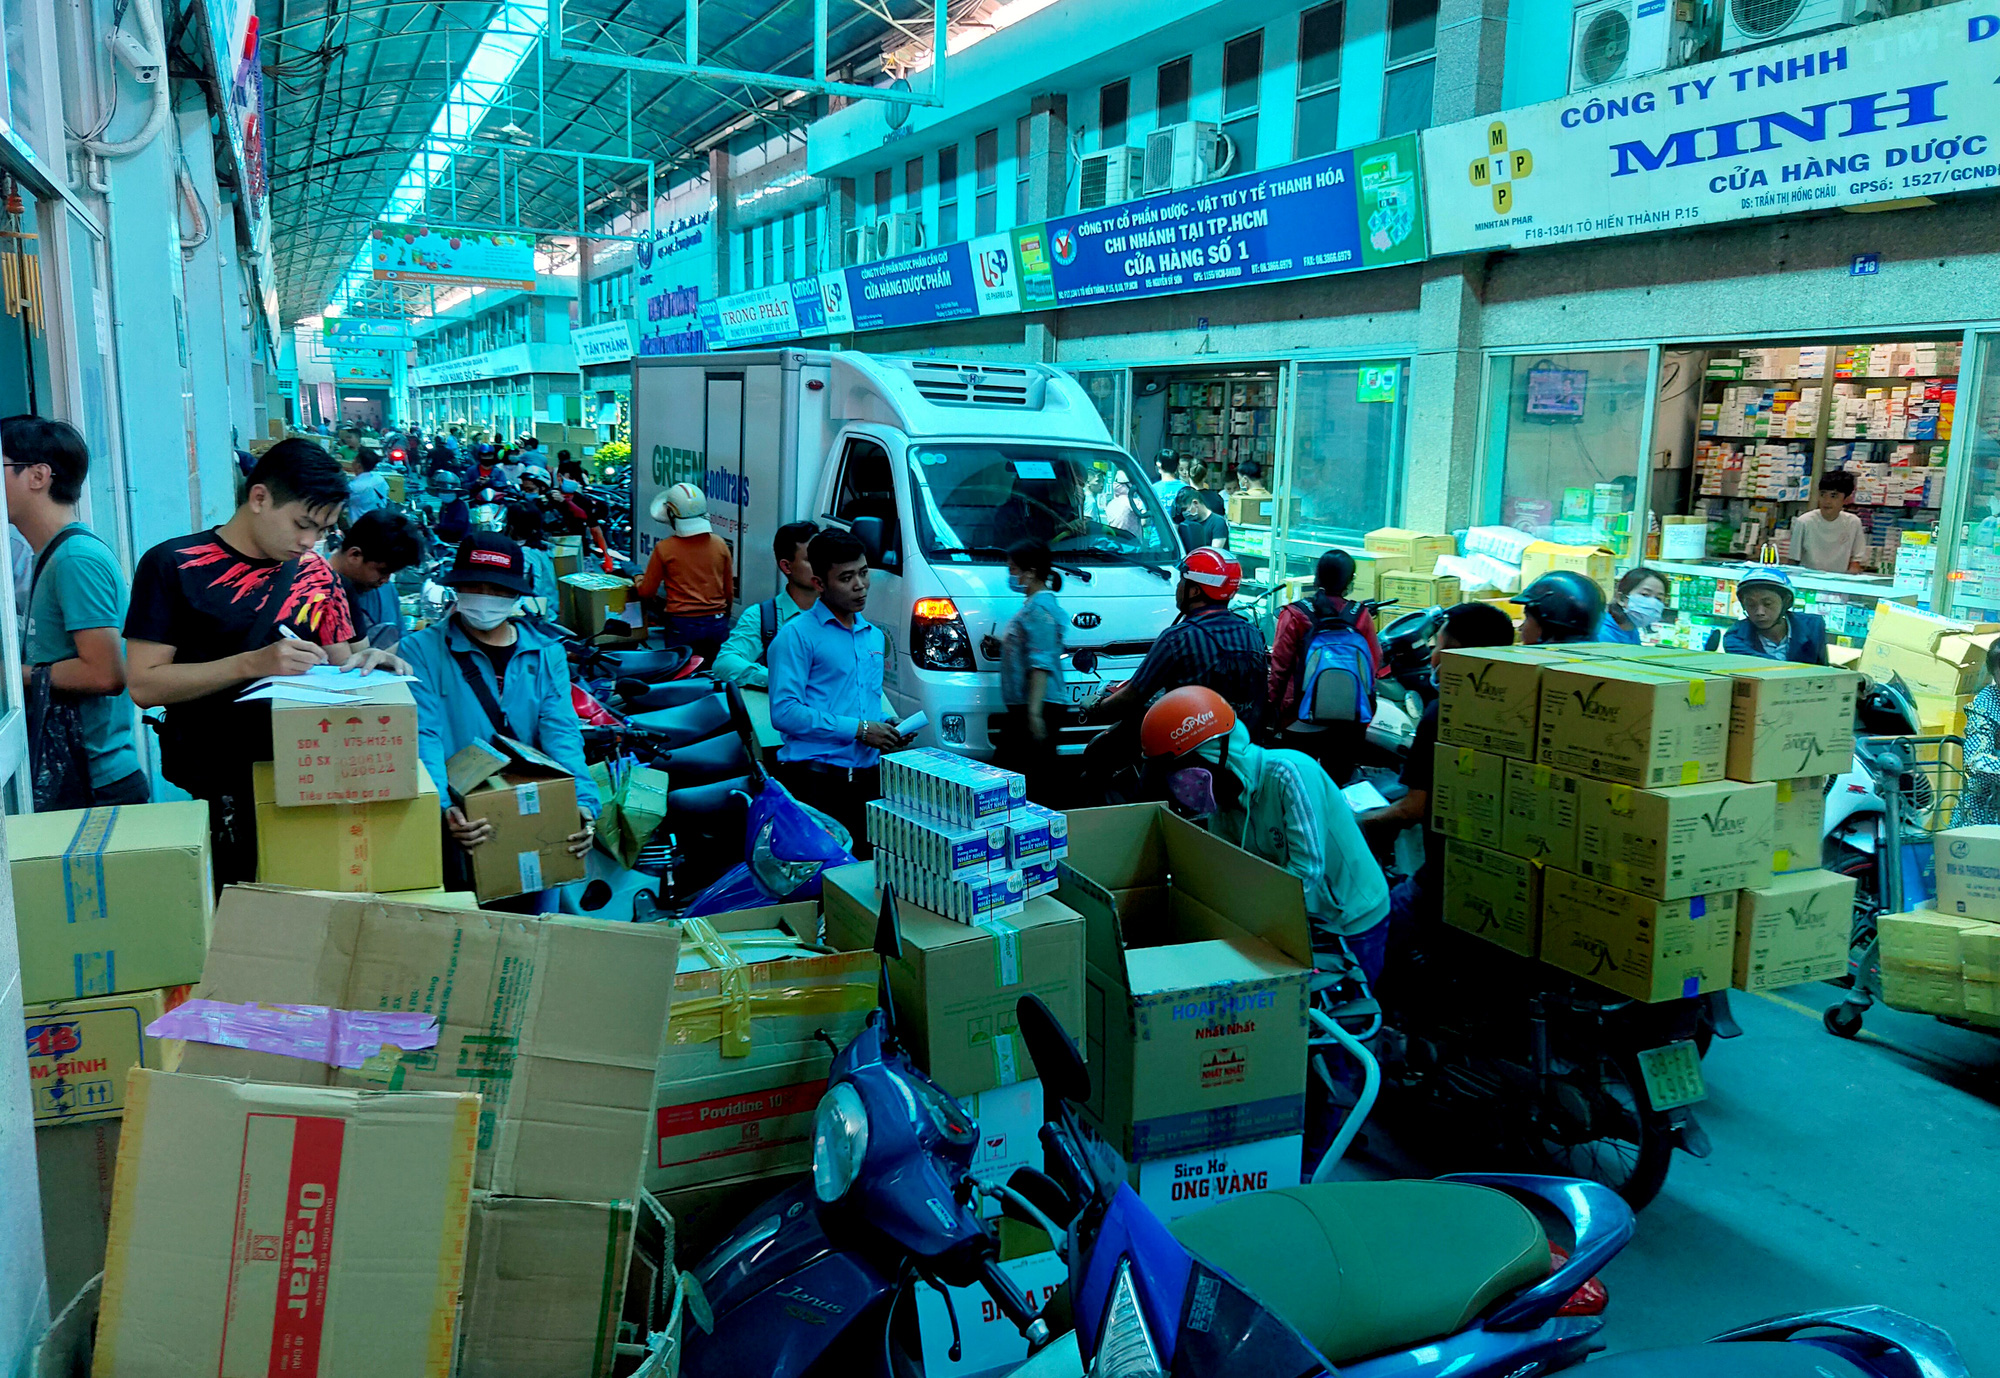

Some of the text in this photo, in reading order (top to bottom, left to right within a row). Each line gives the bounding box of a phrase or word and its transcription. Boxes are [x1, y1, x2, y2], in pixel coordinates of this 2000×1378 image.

[1560, 46, 1848, 129] CÔNG TY TNHH
[1491, 128, 1503, 146] M
[1609, 80, 1949, 178] MINH
[1474, 155, 1525, 180] M T P
[1708, 134, 1988, 194] CỬA HÀNG DƯỢC
[1498, 189, 1507, 205] P
[1754, 193, 1776, 208] TRẦN
[1791, 184, 1813, 202] HỒNG
[1814, 184, 1837, 199] CHÂU
[1850, 176, 1894, 195] GPSố:
[1078, 219, 1102, 237] CÔNG
[1103, 219, 1115, 232] TY
[1160, 203, 1189, 221] DƯỢC
[1197, 194, 1218, 214] VẬT
[1220, 189, 1237, 208] TƯ
[1238, 189, 1248, 204] Y
[1250, 180, 1267, 202] TẾ
[1269, 174, 1312, 198] THANH
[1315, 166, 1346, 189] HÓA
[1104, 208, 1269, 254] CHI NHÁNH TẠI TP.HCM
[1511, 214, 1534, 226] PHAR
[1525, 205, 1699, 240] F18-134/1 TÔ HIẾN THÀNH P.15
[1124, 235, 1250, 277] CỬA HÀNG SỐ 1
[1853, 256, 1876, 274] F18
[864, 268, 952, 301] CỬA HÀNG DƯỢC PHẨM
[722, 298, 790, 327] TRỌNG PHÁT
[652, 444, 703, 489] GREEN
[471, 551, 511, 566] Supreme
[1076, 614, 1099, 627] KIA
[317, 756, 331, 766] SX
[299, 790, 323, 801] Tiêu
[1172, 990, 1278, 1023] HOẠT HUYẾT
[1195, 1021, 1256, 1040] Nhất Nhất
[56, 1057, 108, 1077] BÌNH
[700, 1099, 764, 1121] Povidine
[1174, 1158, 1226, 1179] Siro Ho
[1171, 1169, 1268, 1202] ONG VÀNG
[288, 1182, 326, 1320] Orafar
[776, 1285, 848, 1316] Janus
[292, 1347, 303, 1371] CHAI
